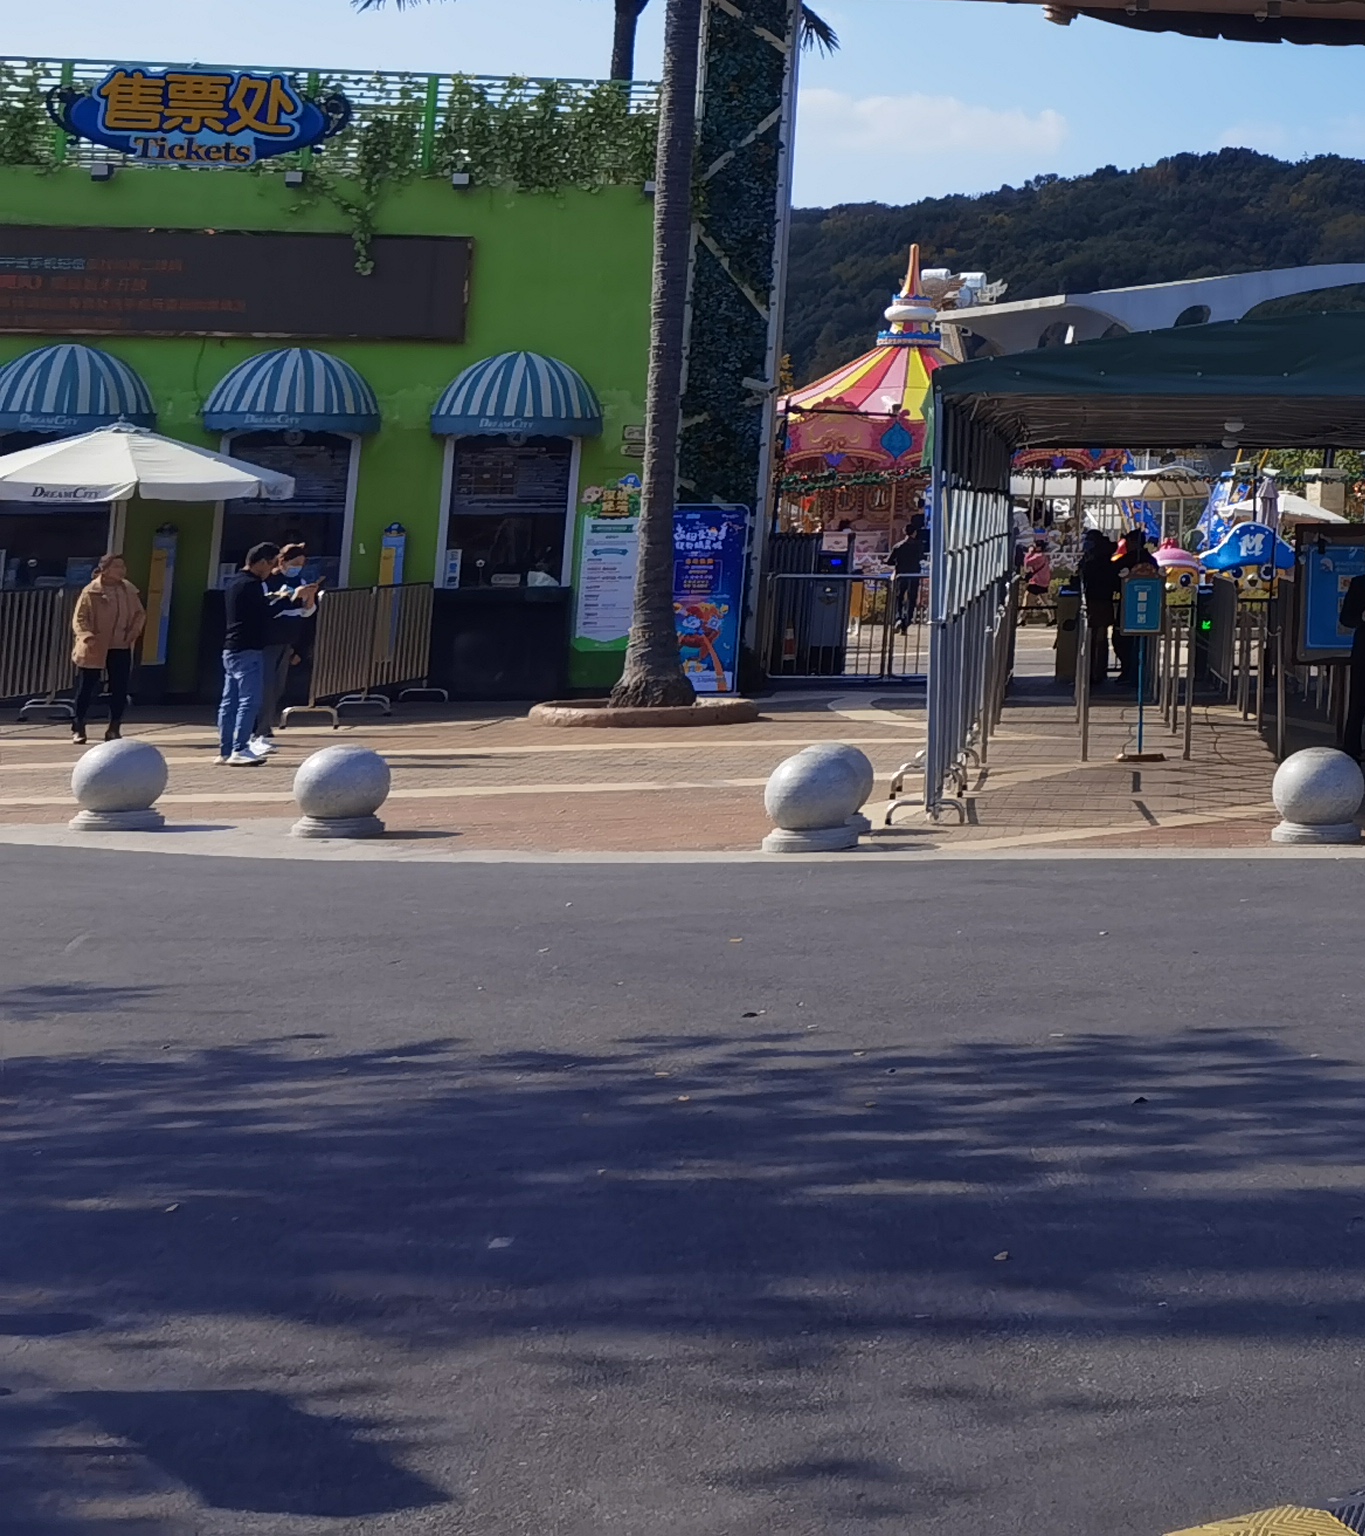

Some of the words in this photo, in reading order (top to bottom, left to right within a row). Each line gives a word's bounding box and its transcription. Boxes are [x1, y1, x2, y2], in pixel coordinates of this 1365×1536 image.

[100, 70, 295, 134] 售票处
[134, 136, 251, 163] Tickets
